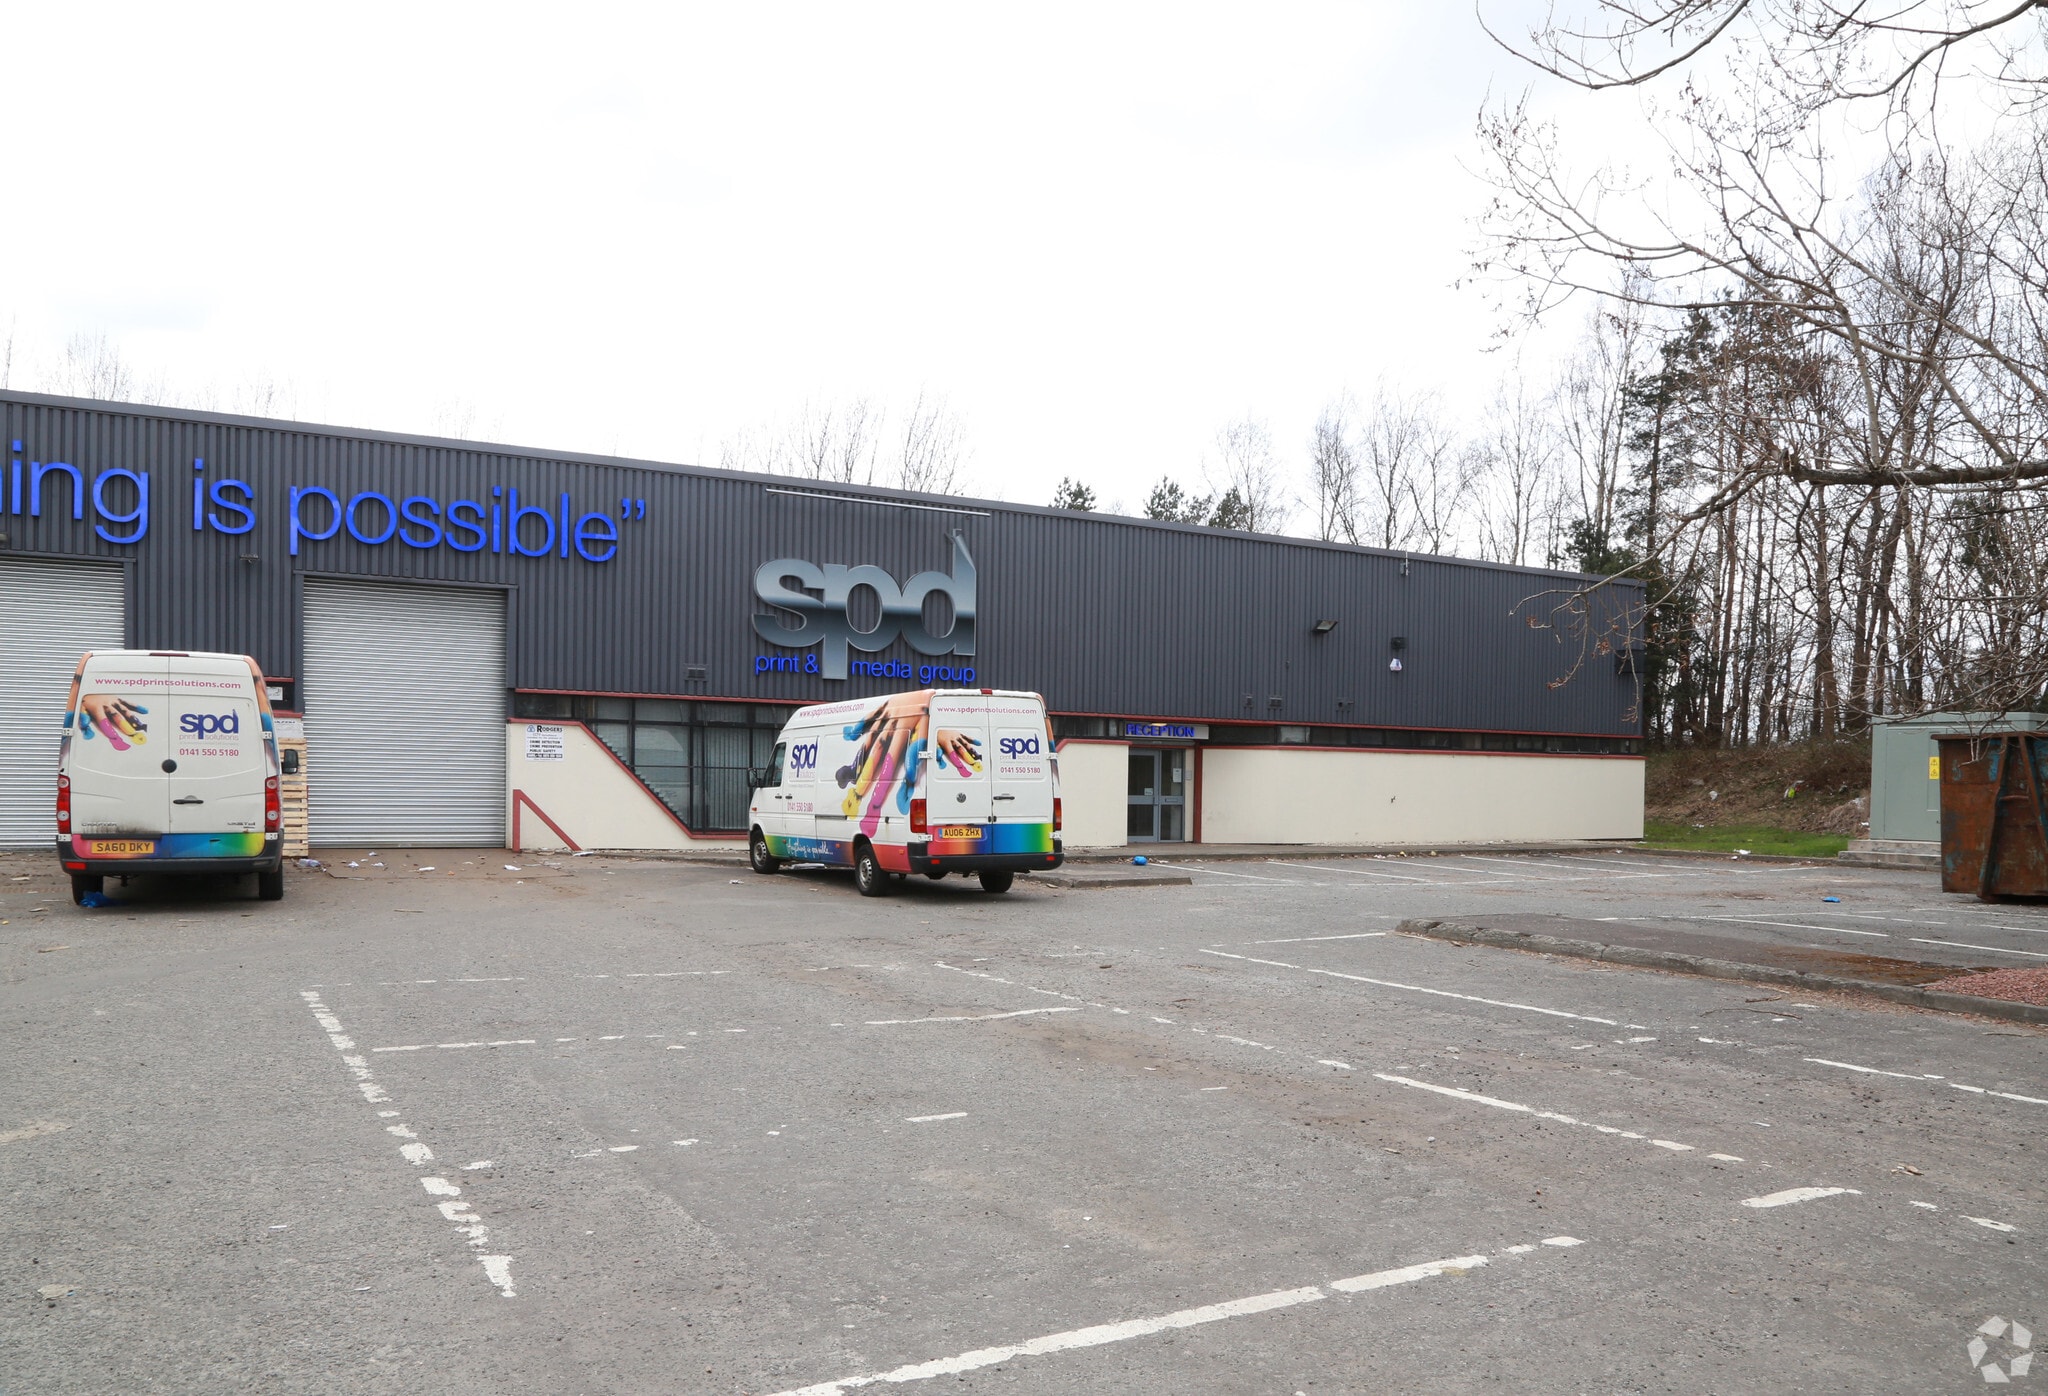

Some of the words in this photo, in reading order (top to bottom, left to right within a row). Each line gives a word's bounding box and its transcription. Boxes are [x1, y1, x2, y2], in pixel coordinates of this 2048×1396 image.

[0, 439, 148, 544] ing
[194, 458, 256, 534] is
[752, 529, 977, 680] spd
[755, 652, 799, 675] print
[804, 653, 819, 673] &
[851, 659, 912, 678] media
[919, 664, 975, 685] group
[95, 678, 241, 689] www.spdprintsolutions.com
[937, 706, 1037, 715] www.spdprintsolutions.com
[180, 709, 239, 739] spd
[1126, 723, 1195, 738] RECEPTION
[179, 748, 200, 756] 0141
[202, 748, 217, 757] 550
[219, 749, 239, 757] 5180
[1000, 733, 1040, 759] spd
[791, 735, 819, 778] spd
[944, 828, 963, 837] AU06
[965, 828, 980, 836] ZHX
[97, 842, 126, 852] SA60
[129, 842, 151, 852] DKY
